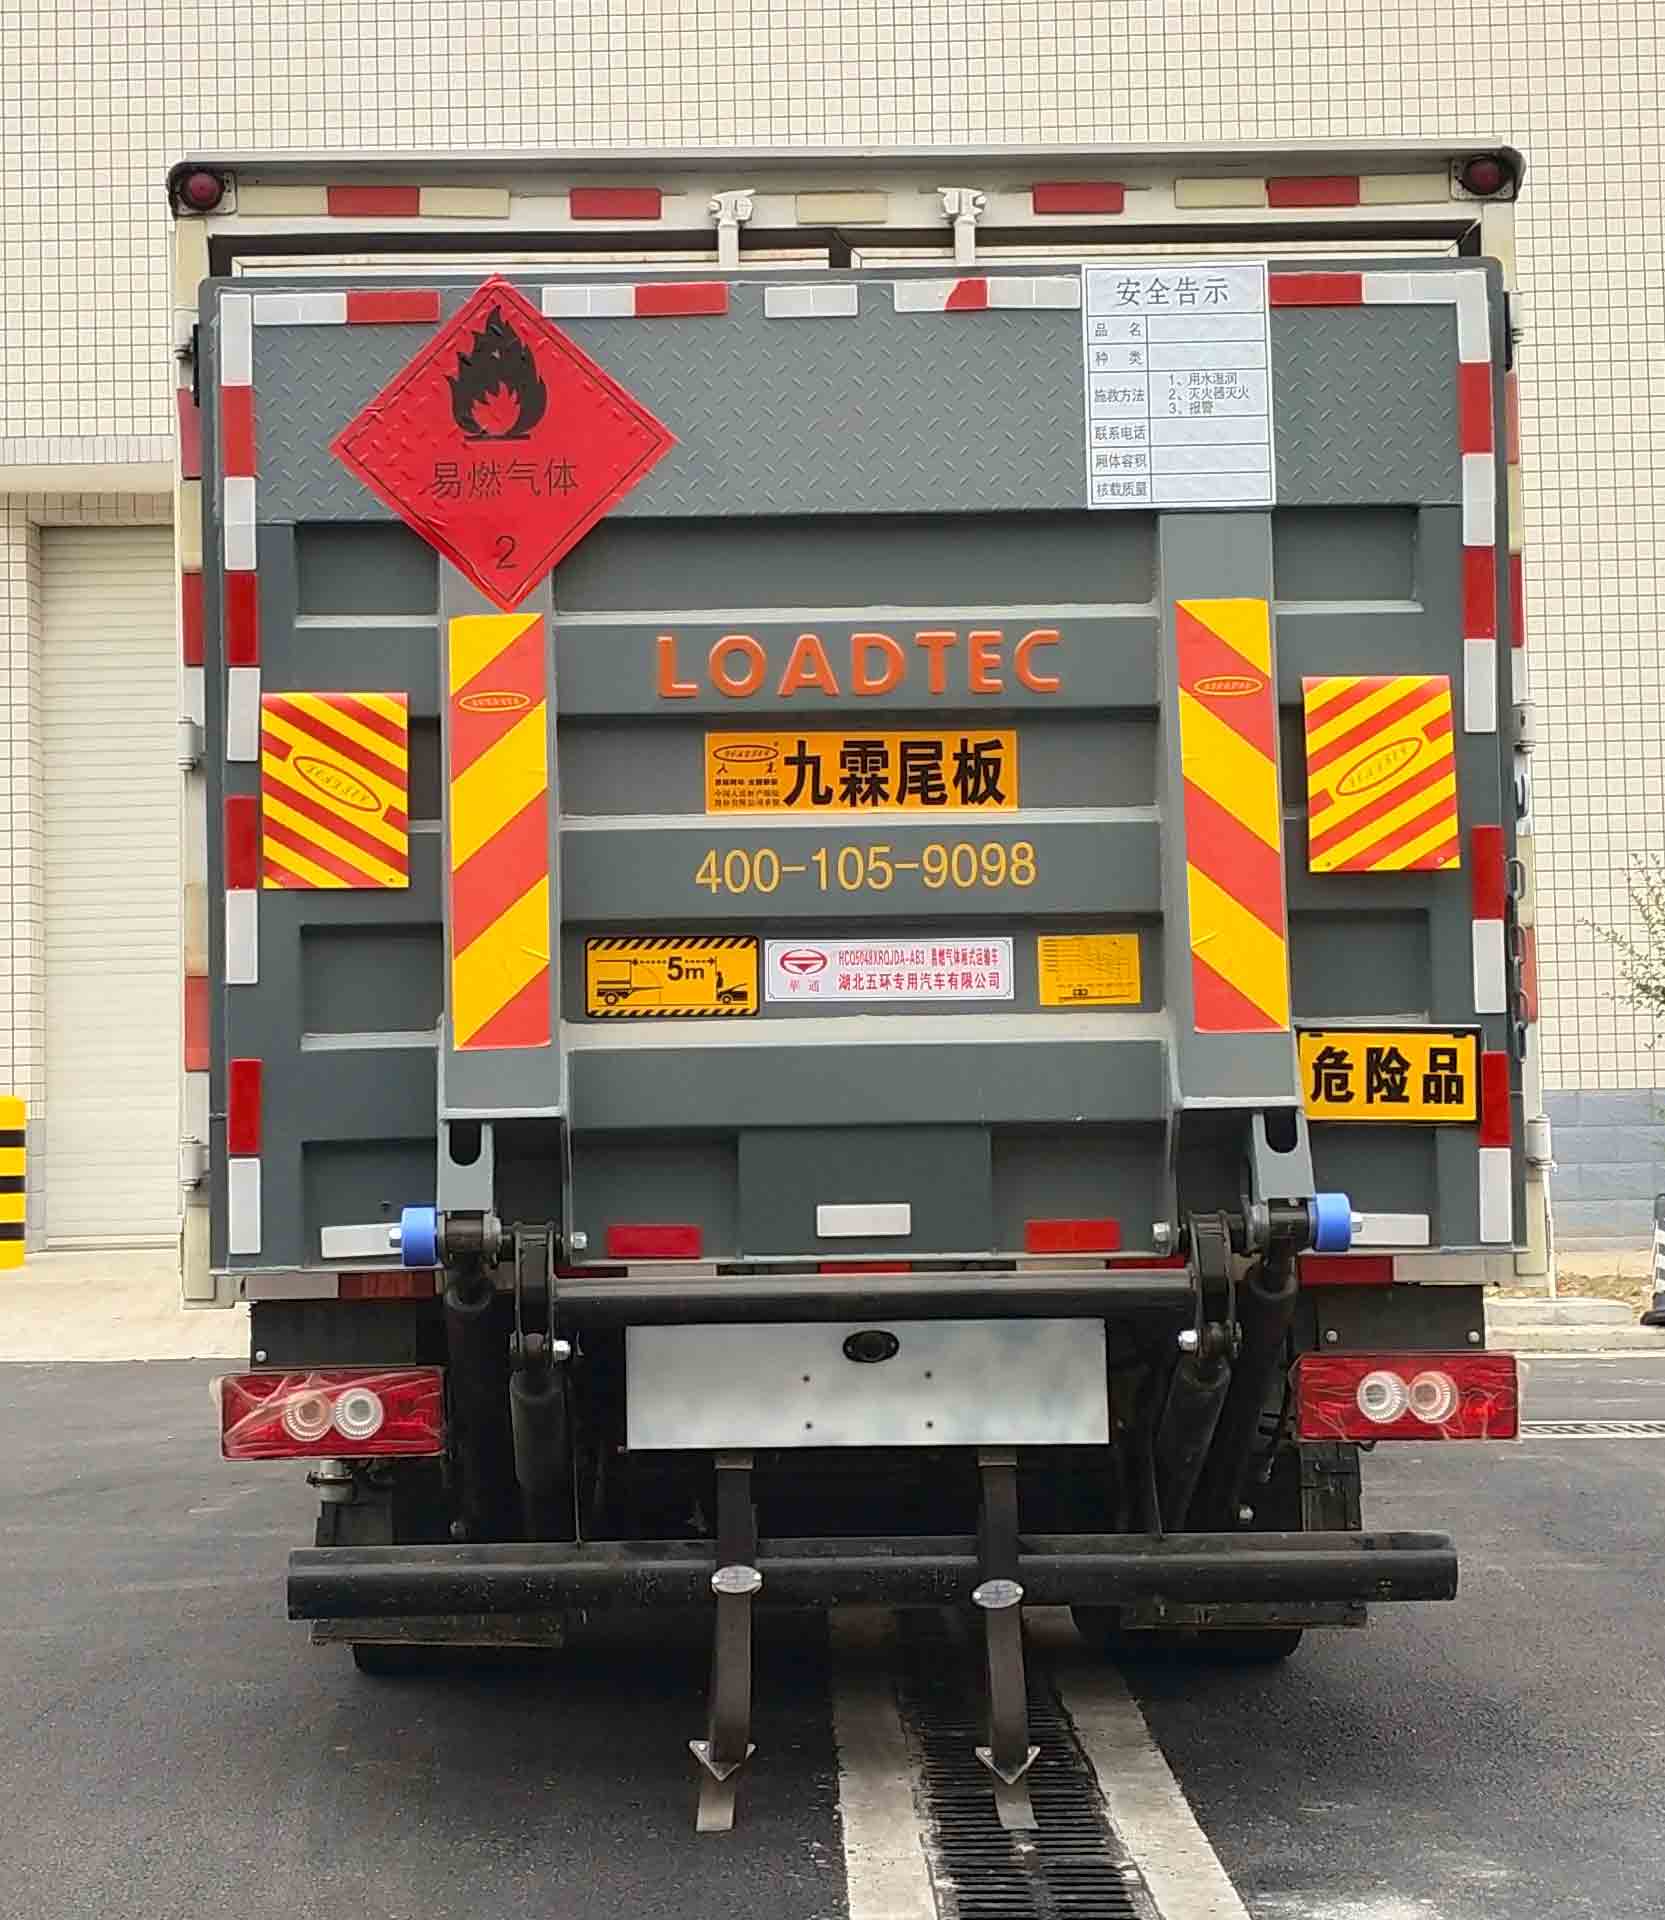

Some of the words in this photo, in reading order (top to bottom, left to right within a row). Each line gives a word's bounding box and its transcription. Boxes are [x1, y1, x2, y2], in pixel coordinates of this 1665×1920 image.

[1115, 277, 1230, 307] 安全告示
[1094, 425, 1146, 441] 联系电话
[431, 456, 578, 499] 易燃气体
[1096, 481, 1148, 497] 核载质量
[495, 535, 517, 569] 2
[657, 629, 1060, 698] LOADTEC
[783, 738, 1007, 808] 九霖尾板
[695, 841, 1037, 894] 400-105-9098
[667, 956, 705, 981] 5m
[838, 972, 1001, 992] 湖北五环专用汽车有限公司
[1310, 1045, 1465, 1105] 危险品
